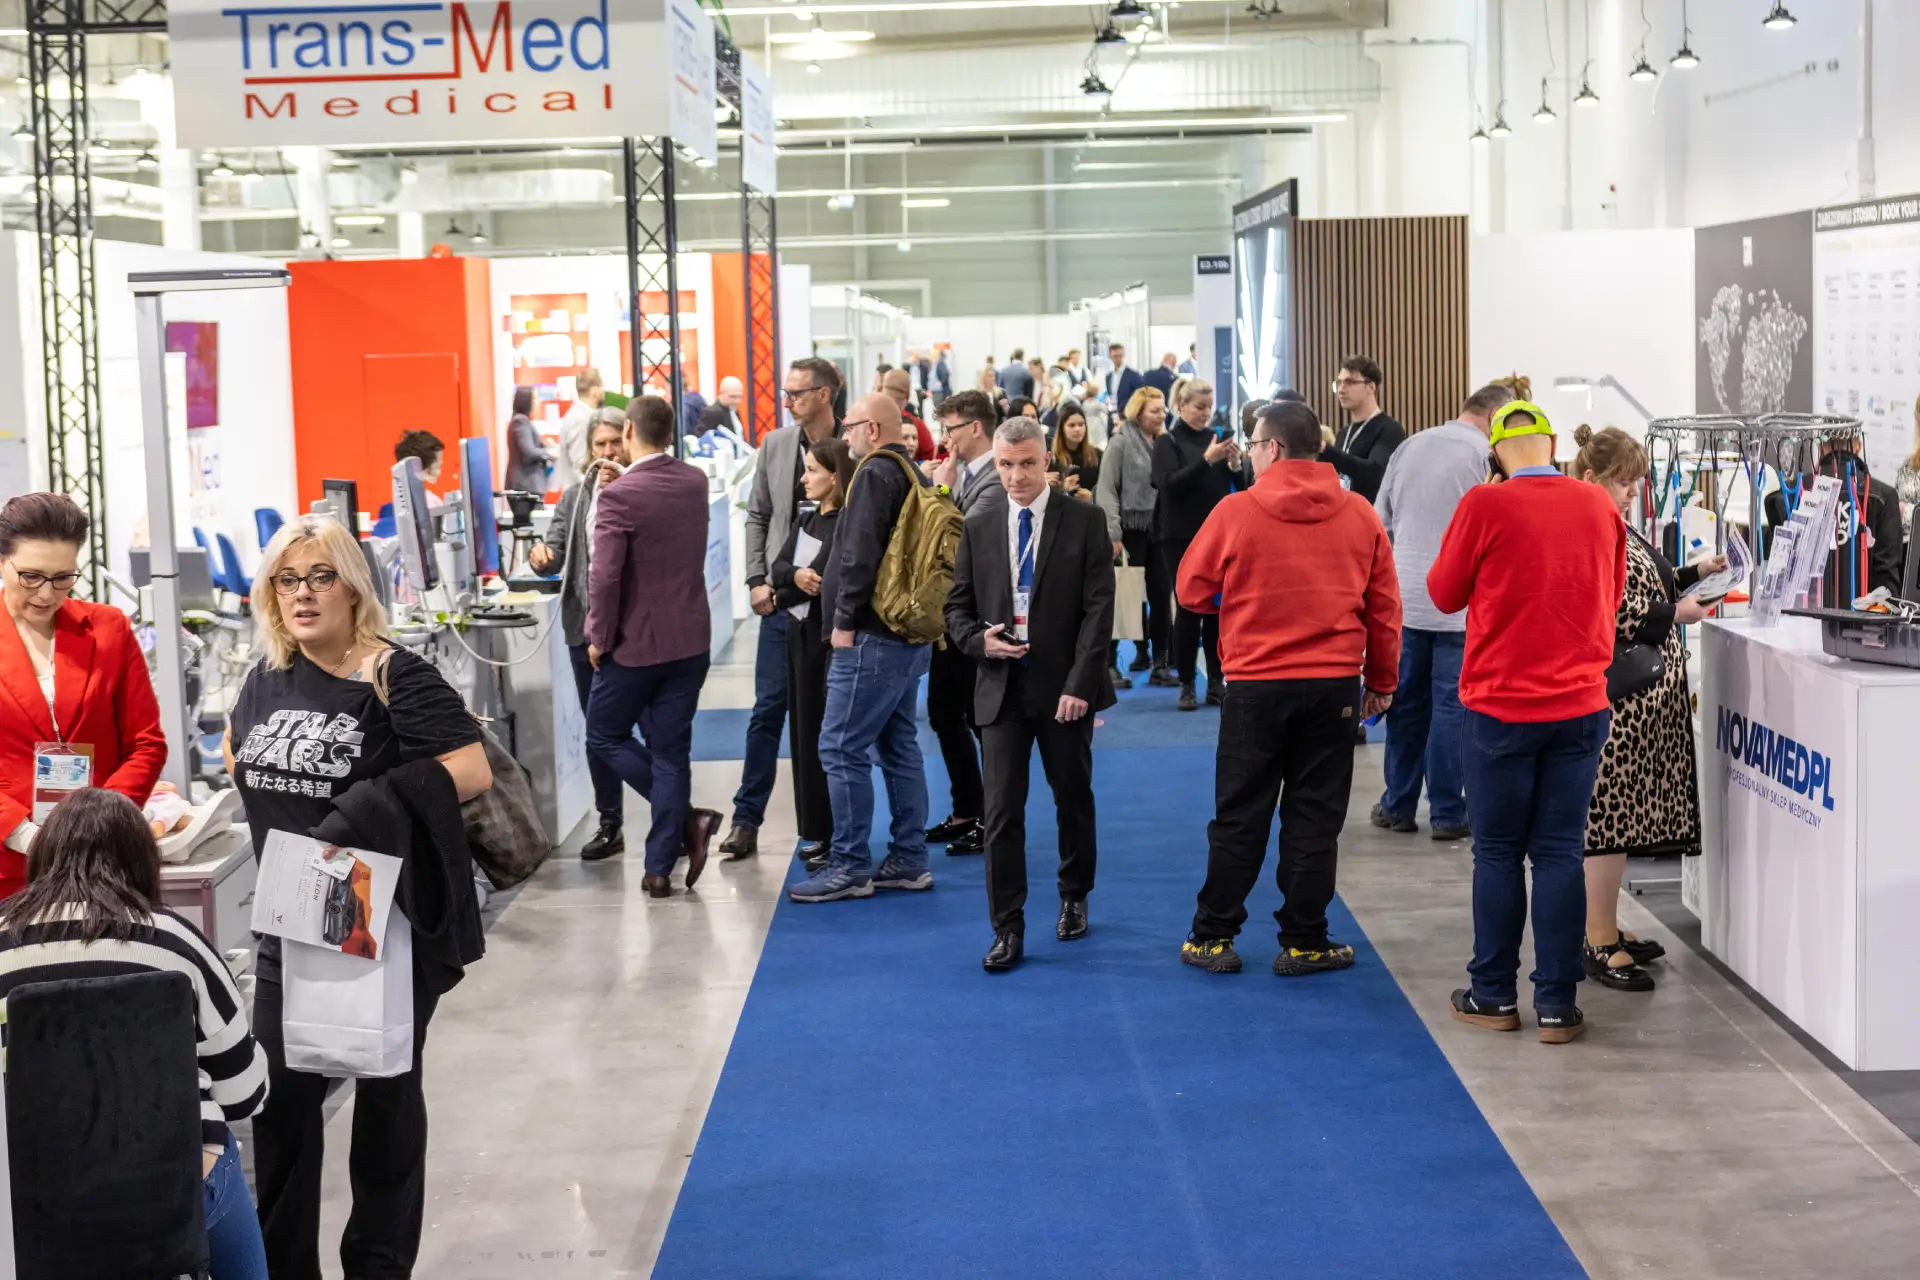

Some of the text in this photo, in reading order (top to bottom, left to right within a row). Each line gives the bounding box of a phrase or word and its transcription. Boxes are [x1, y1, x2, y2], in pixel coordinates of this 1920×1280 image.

[222, 0, 610, 80] Trans-Med
[244, 83, 613, 119] Medical
[1882, 202, 1900, 220] BOOK
[249, 709, 365, 745] STAR
[235, 734, 362, 778] WARS
[245, 769, 333, 798] 新たなる希望
[1726, 765, 1822, 830] PROFESJONALNY SKLEP MEDYCZNY
[313, 878, 324, 902] LEON
